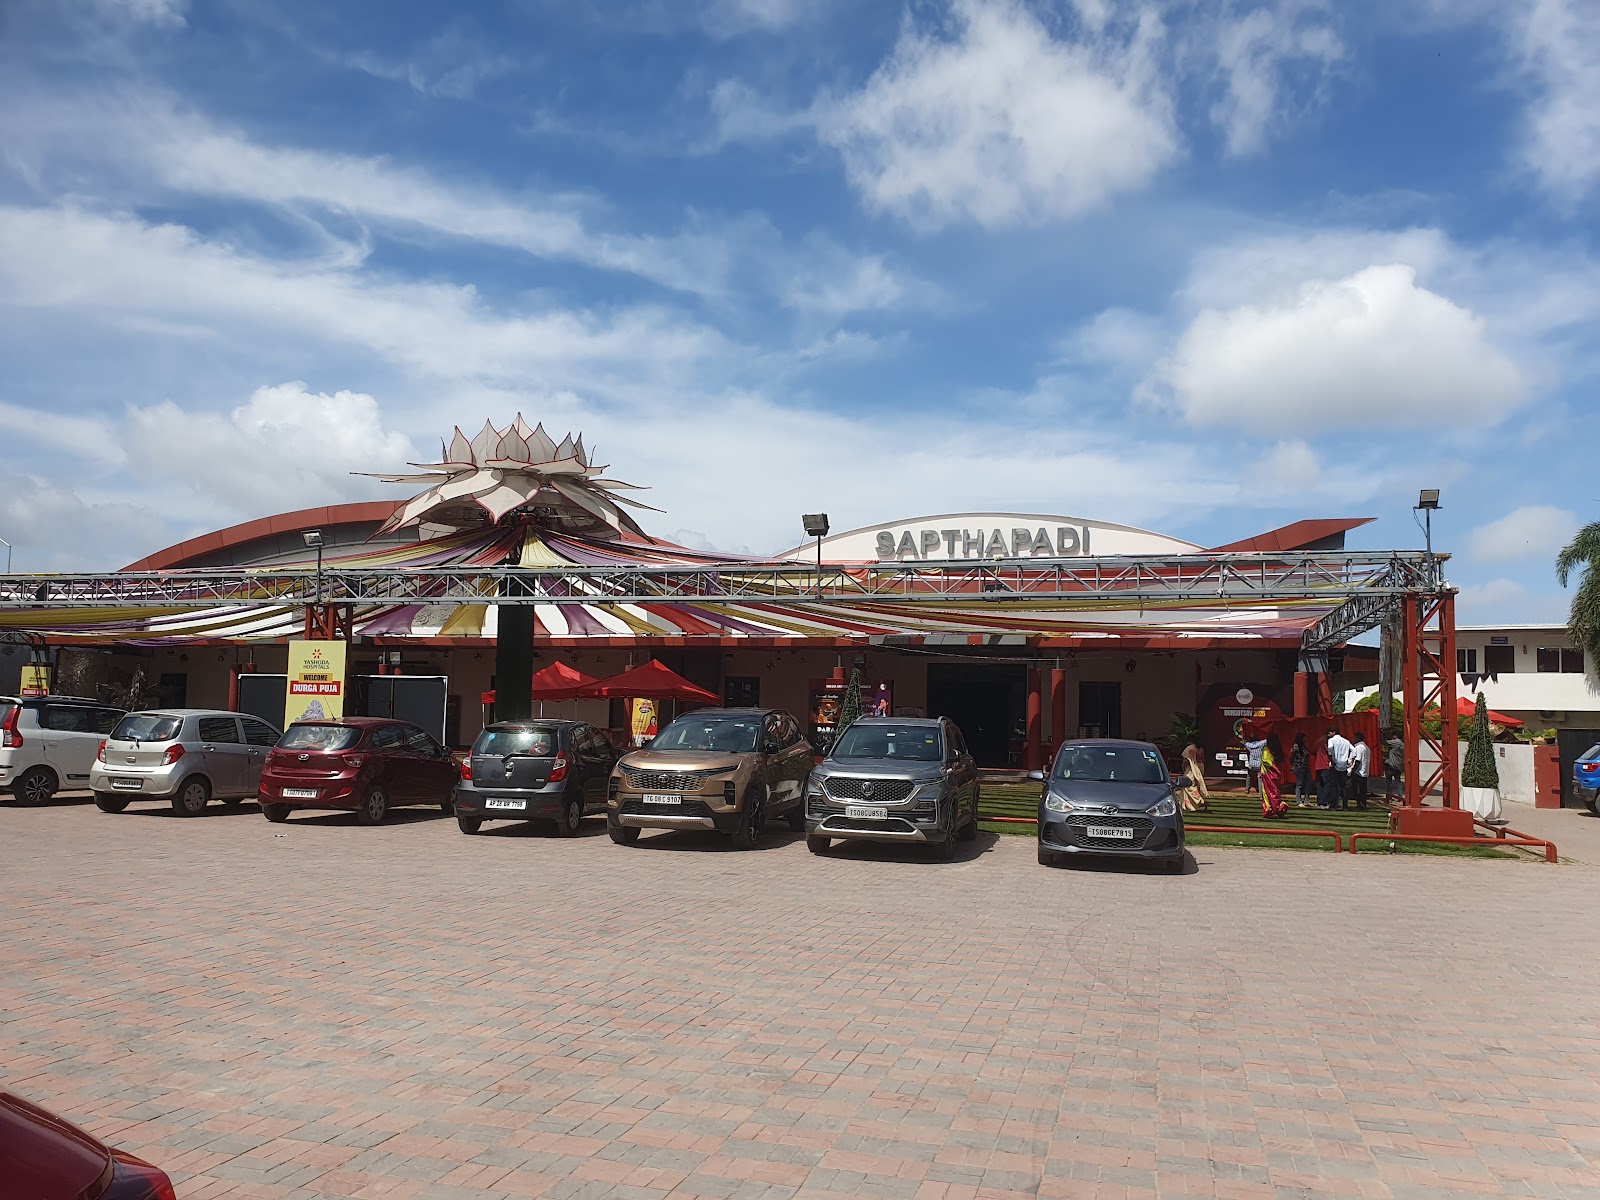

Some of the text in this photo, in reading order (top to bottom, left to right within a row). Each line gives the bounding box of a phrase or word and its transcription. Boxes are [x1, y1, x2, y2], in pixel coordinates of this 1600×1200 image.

[875, 526, 1090, 556] SAPTHAPADI
[292, 683, 338, 693] DURGA PUJA
[667, 796, 681, 804] 9107
